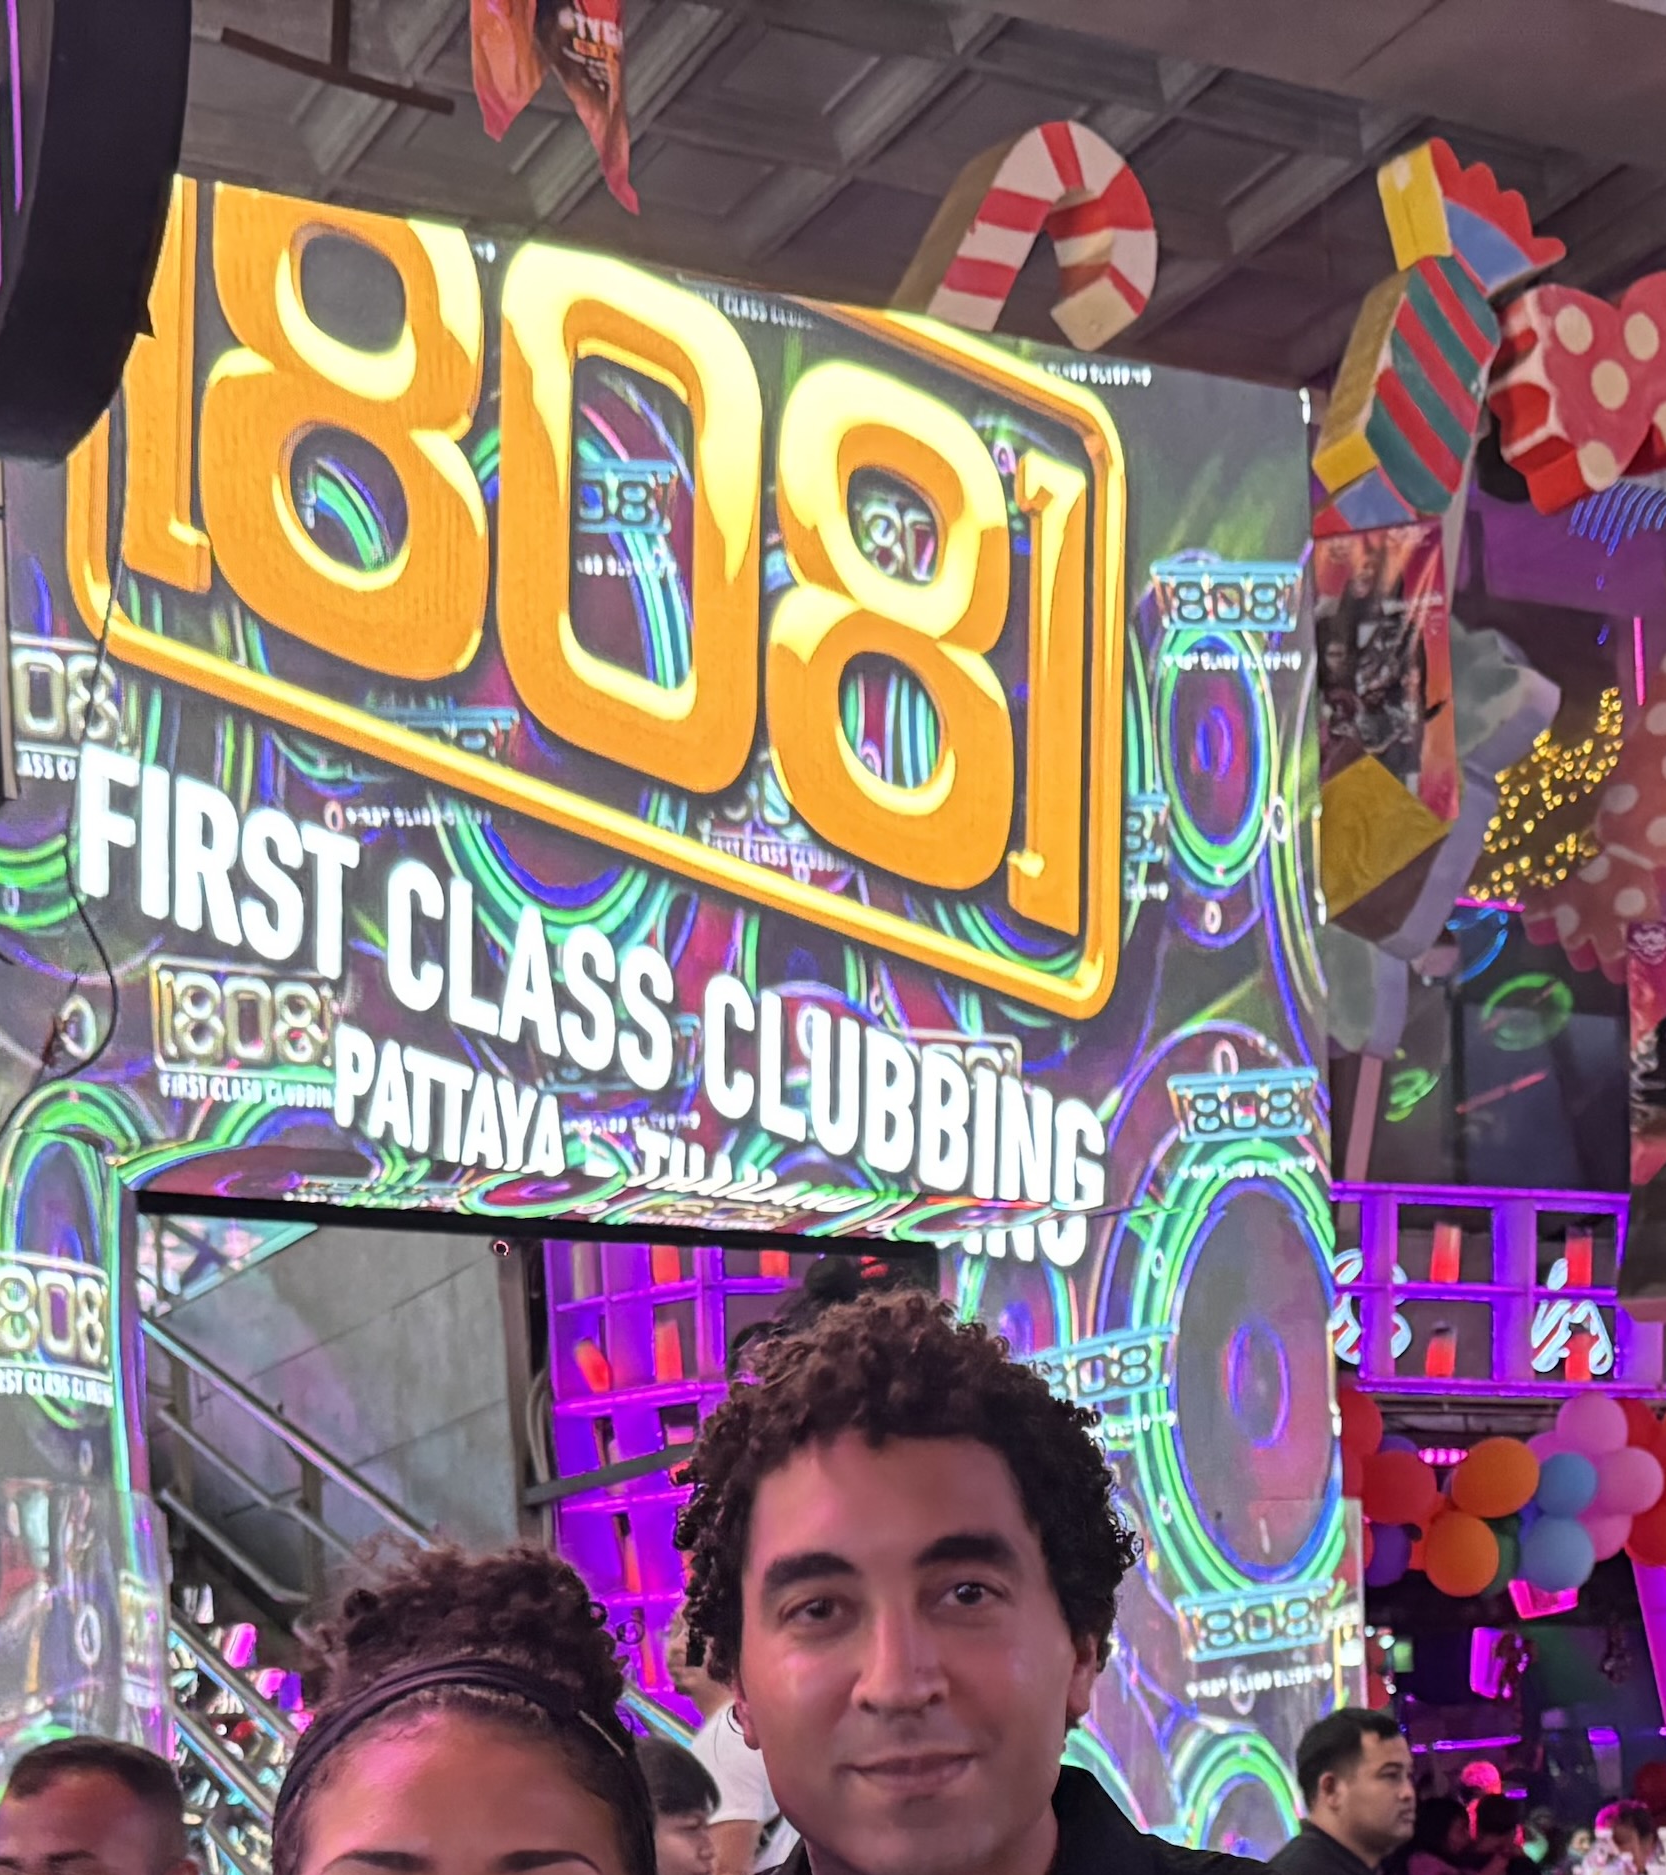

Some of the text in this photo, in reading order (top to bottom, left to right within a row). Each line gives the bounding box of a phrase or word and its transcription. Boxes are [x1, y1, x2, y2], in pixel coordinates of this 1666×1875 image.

[79, 742, 1107, 1212] FIRST CLASS CLUBBING
[333, 1022, 566, 1178] PATTAYA
